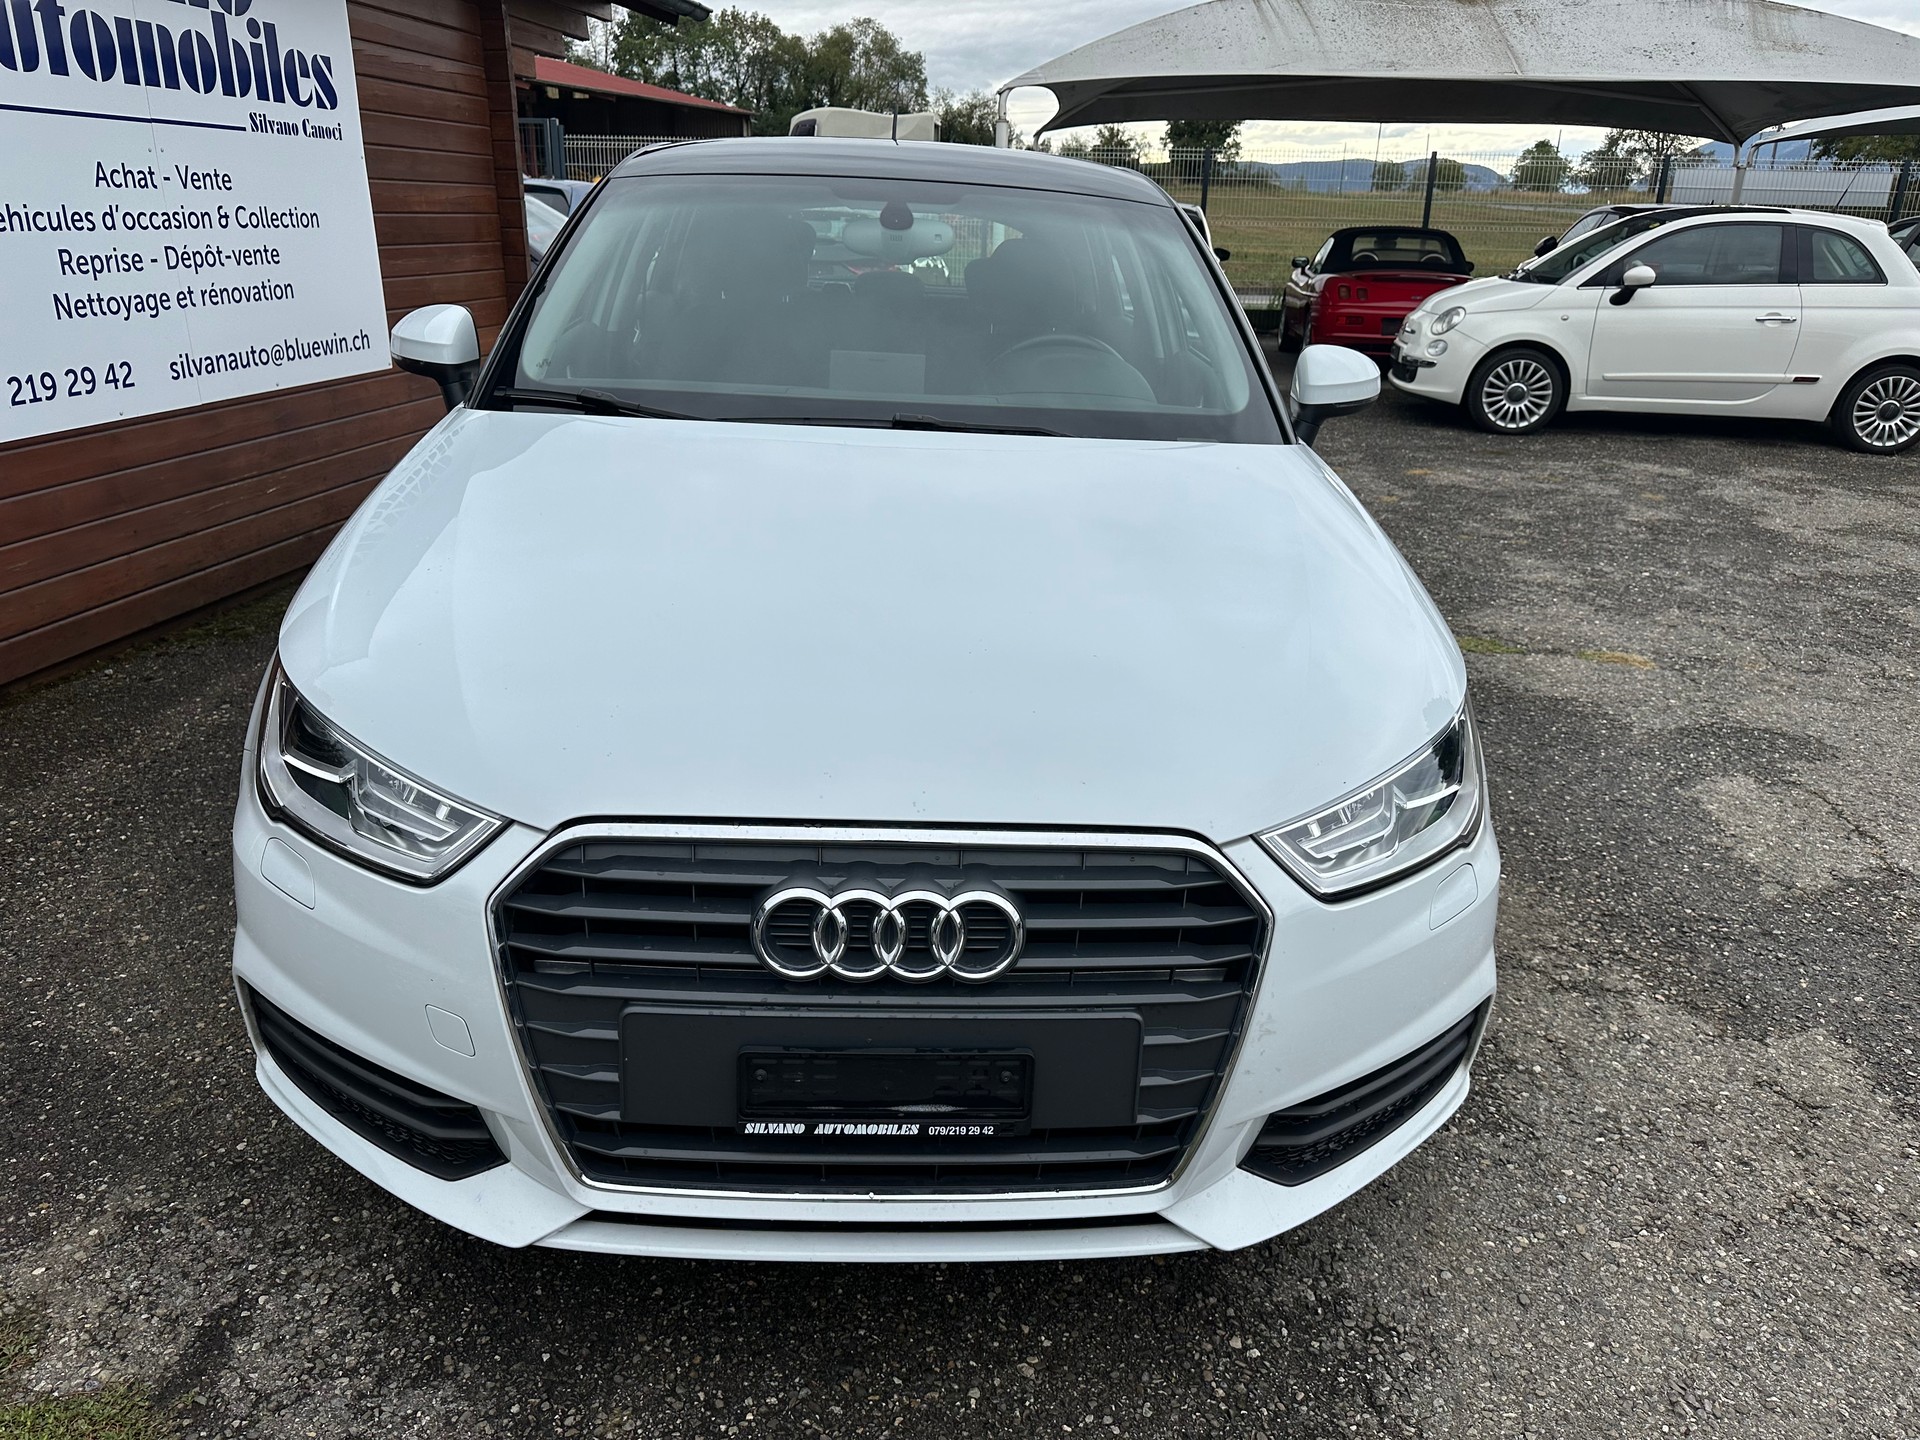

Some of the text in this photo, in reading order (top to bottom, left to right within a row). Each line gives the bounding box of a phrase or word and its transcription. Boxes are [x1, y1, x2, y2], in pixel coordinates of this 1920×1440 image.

[0, 0, 338, 111] utomobiles
[249, 112, 342, 140] Silvano Canoci
[96, 162, 157, 189] Achat
[175, 165, 232, 191] Vente
[102, 205, 212, 230] d'occasion
[217, 206, 229, 229] &
[235, 206, 319, 228] Collection
[58, 247, 144, 281] Reprise
[164, 244, 280, 274] Dépôt-vente
[53, 279, 294, 321] Nettoyage et rénovation
[7, 329, 371, 406] 219 29 42 silvanauto@bluewin.ch
[744, 1123, 994, 1136] SILVANO AUTOMOBILES 079/219 29 42
